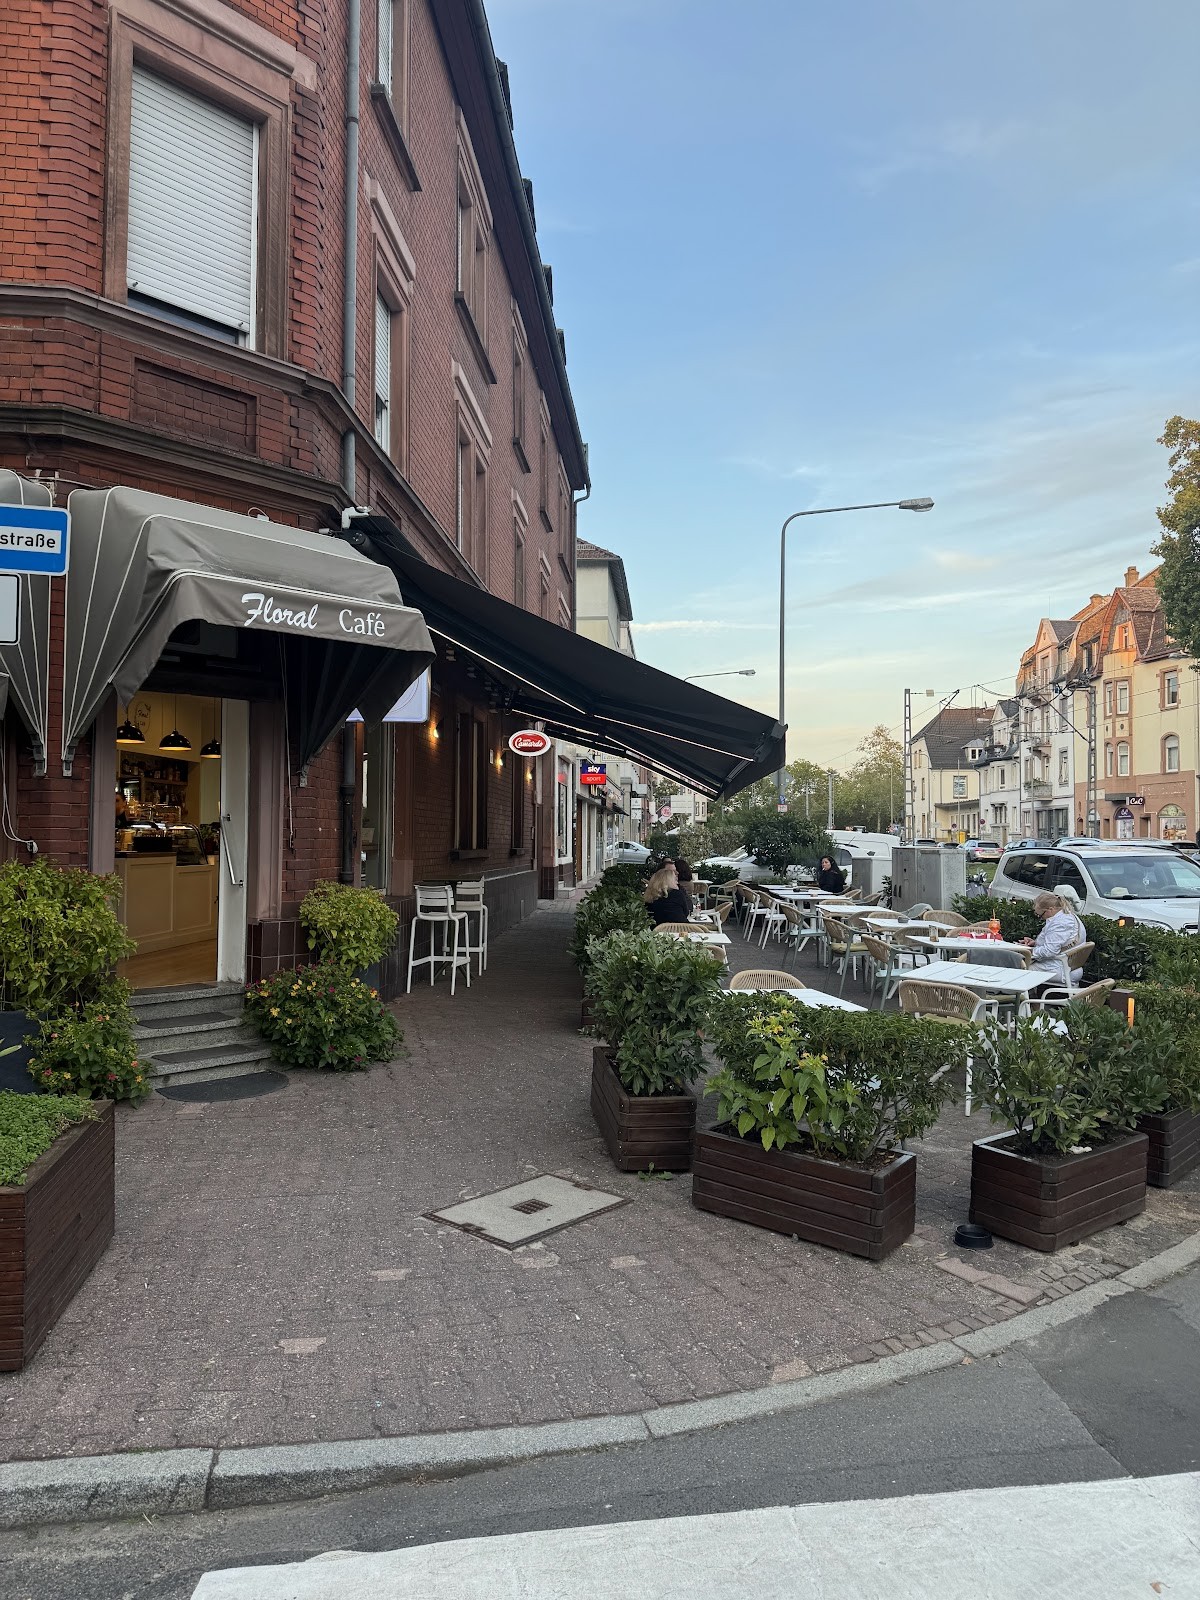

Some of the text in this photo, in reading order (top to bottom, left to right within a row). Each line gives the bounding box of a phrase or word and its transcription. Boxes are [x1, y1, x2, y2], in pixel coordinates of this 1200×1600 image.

[0, 532, 56, 549] straße
[241, 592, 386, 637] Floral Café
[587, 765, 600, 773] sky
